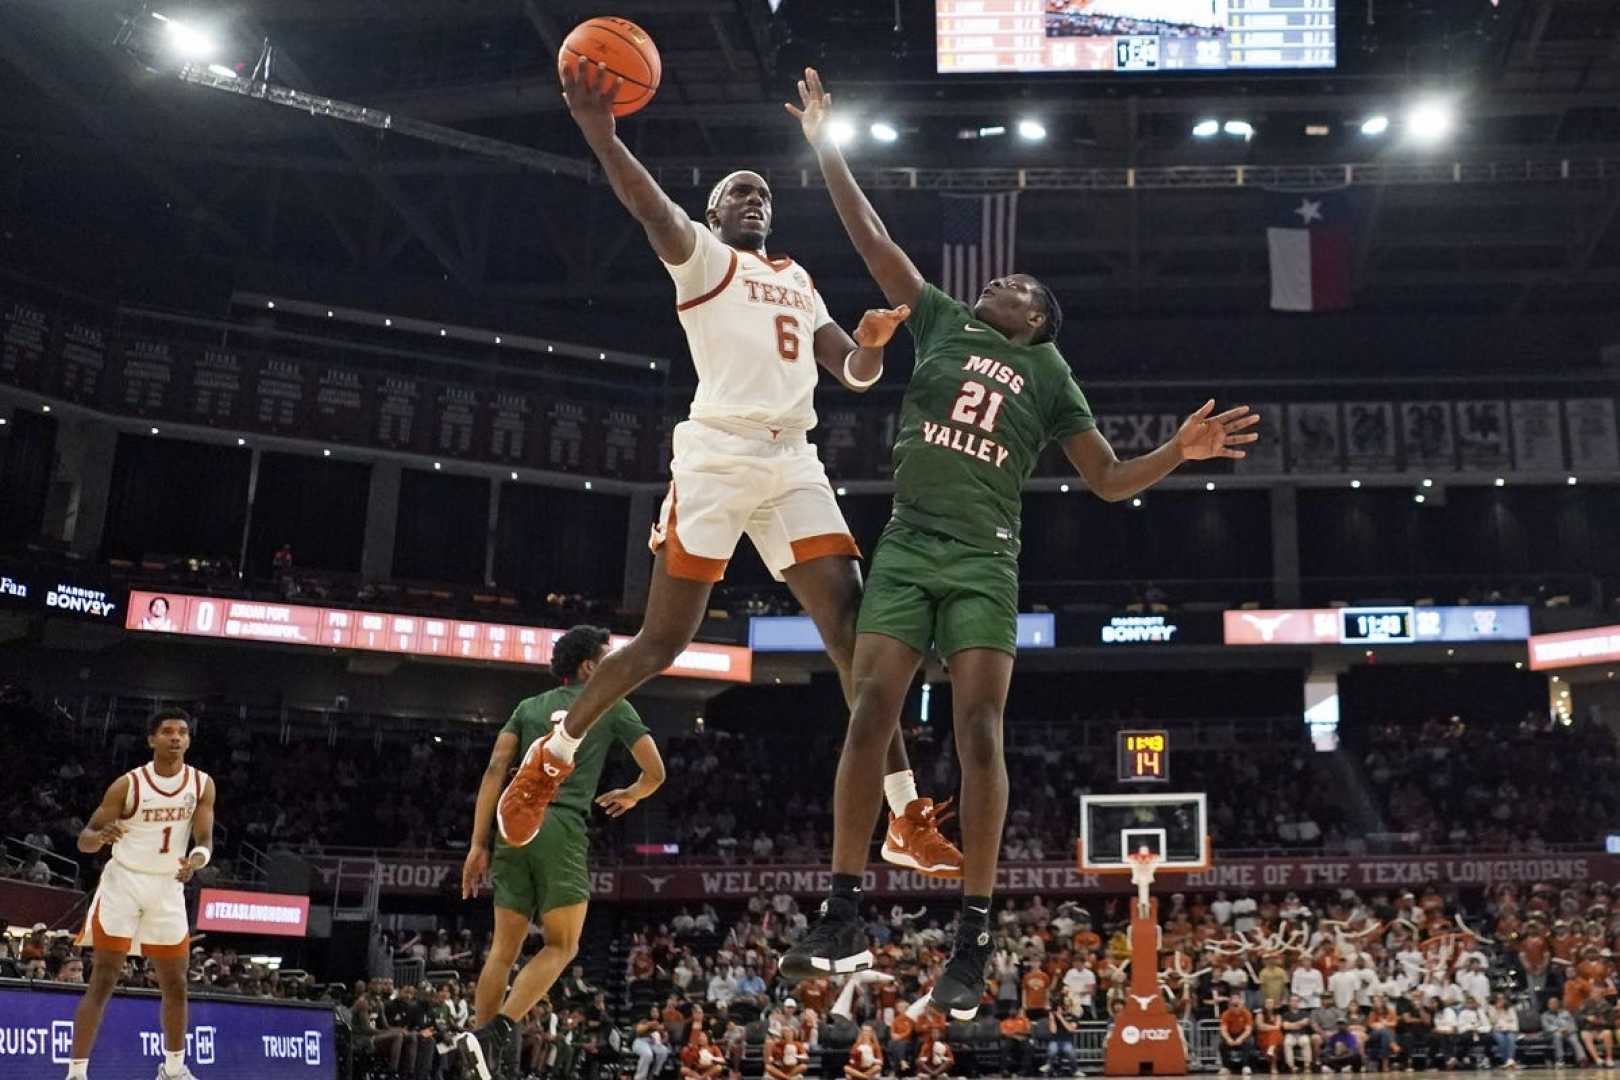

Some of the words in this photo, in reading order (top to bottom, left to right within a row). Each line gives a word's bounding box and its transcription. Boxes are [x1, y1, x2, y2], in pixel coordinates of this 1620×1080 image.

[775, 314, 799, 360] 6
[962, 355, 1025, 395] MISS
[951, 380, 1004, 434] 21
[922, 421, 1009, 468] VALLEY
[1100, 414, 1178, 449] EXA
[0, 577, 27, 597] Fan
[57, 584, 106, 600] MARRIOTT
[46, 591, 113, 617] BONVOY
[197, 601, 214, 631] 0
[1137, 751, 1159, 775] 14
[159, 826, 173, 854] 1
[702, 870, 832, 894] WELCOME
[1186, 865, 1256, 887] HOME
[1262, 865, 1294, 885] OF
[1358, 861, 1439, 885] TEXAS
[1446, 859, 1589, 883] LONGHORNS
[262, 1035, 304, 1058] TRUIST
